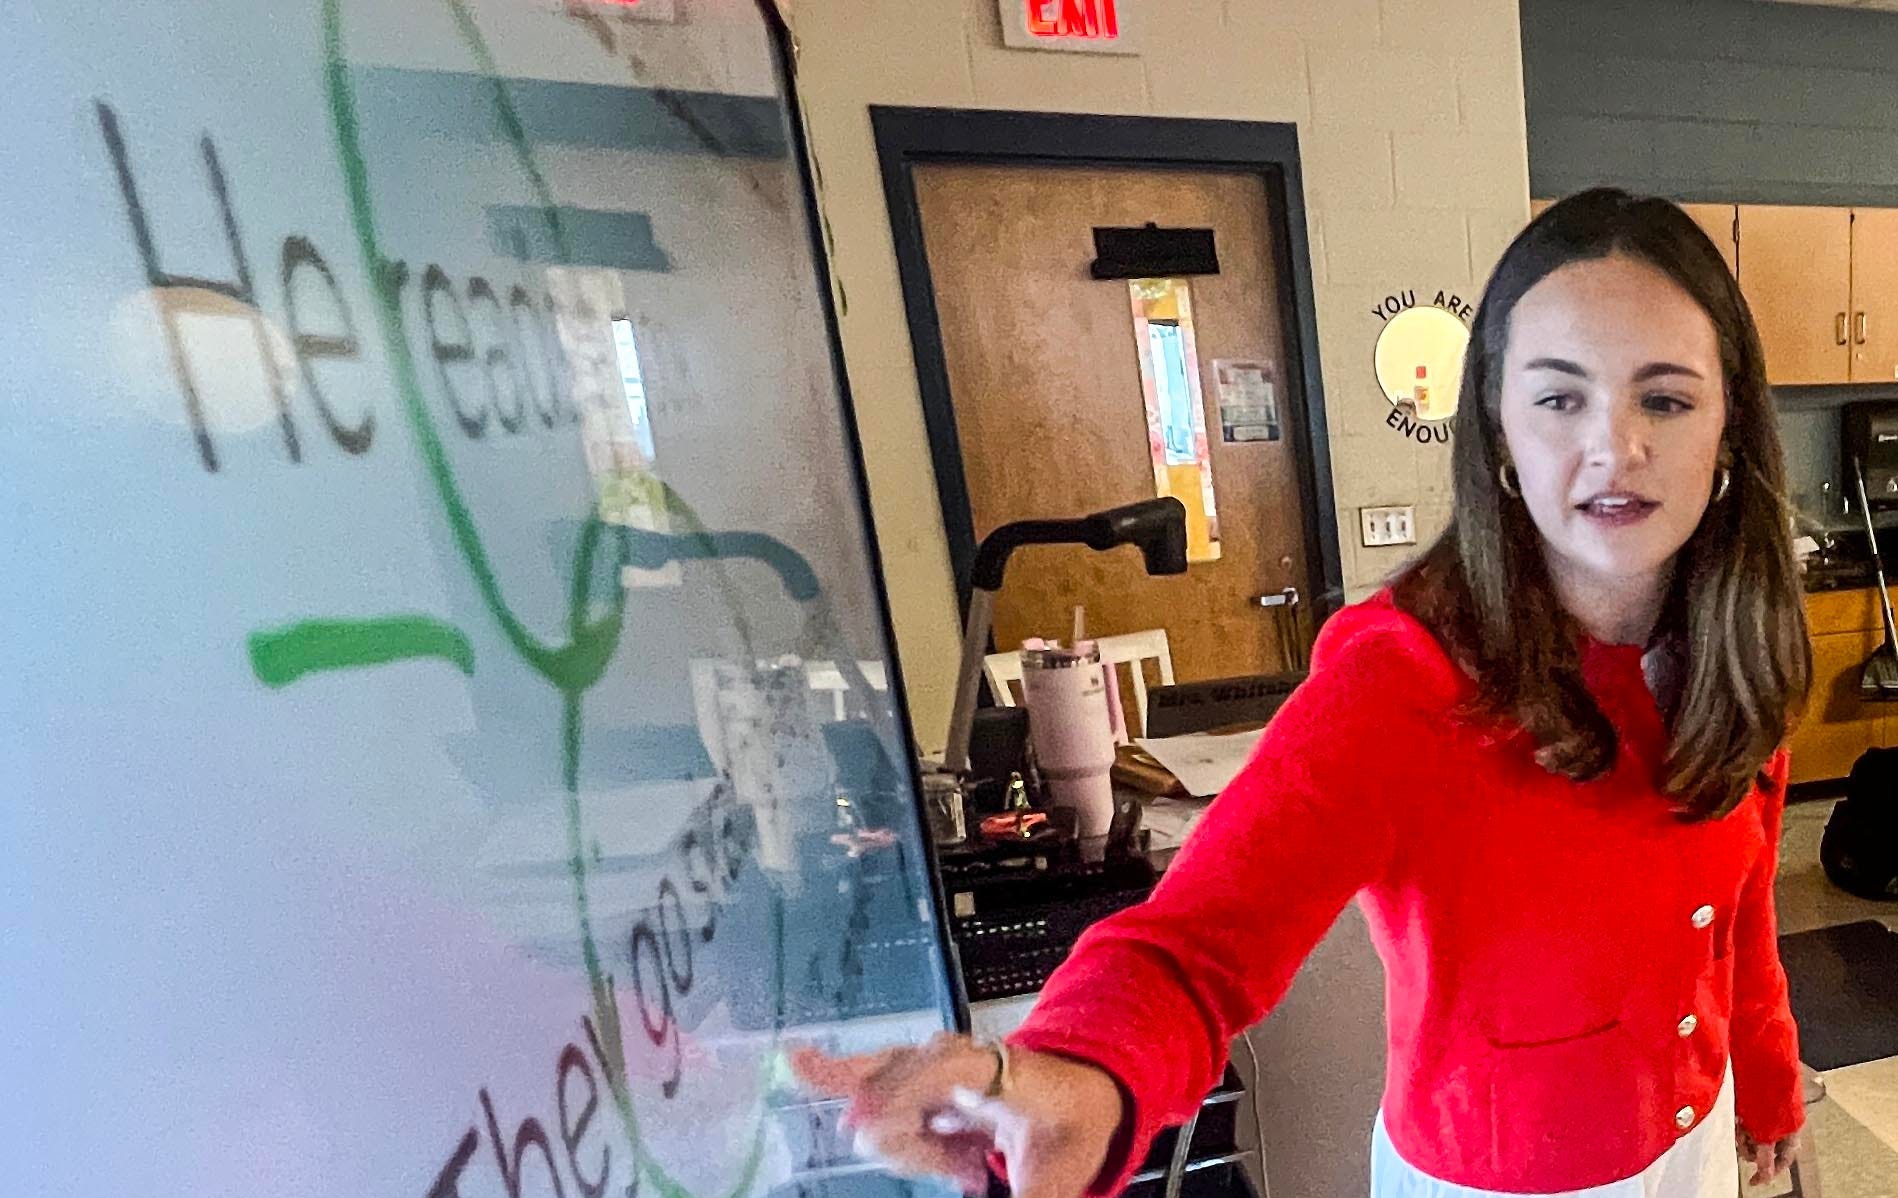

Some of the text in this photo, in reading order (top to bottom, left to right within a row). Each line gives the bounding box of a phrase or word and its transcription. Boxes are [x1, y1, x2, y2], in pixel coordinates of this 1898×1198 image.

[93, 95, 377, 474] He
[1371, 289, 1473, 322] YOU ARE
[1386, 408, 1457, 444] ENOU
